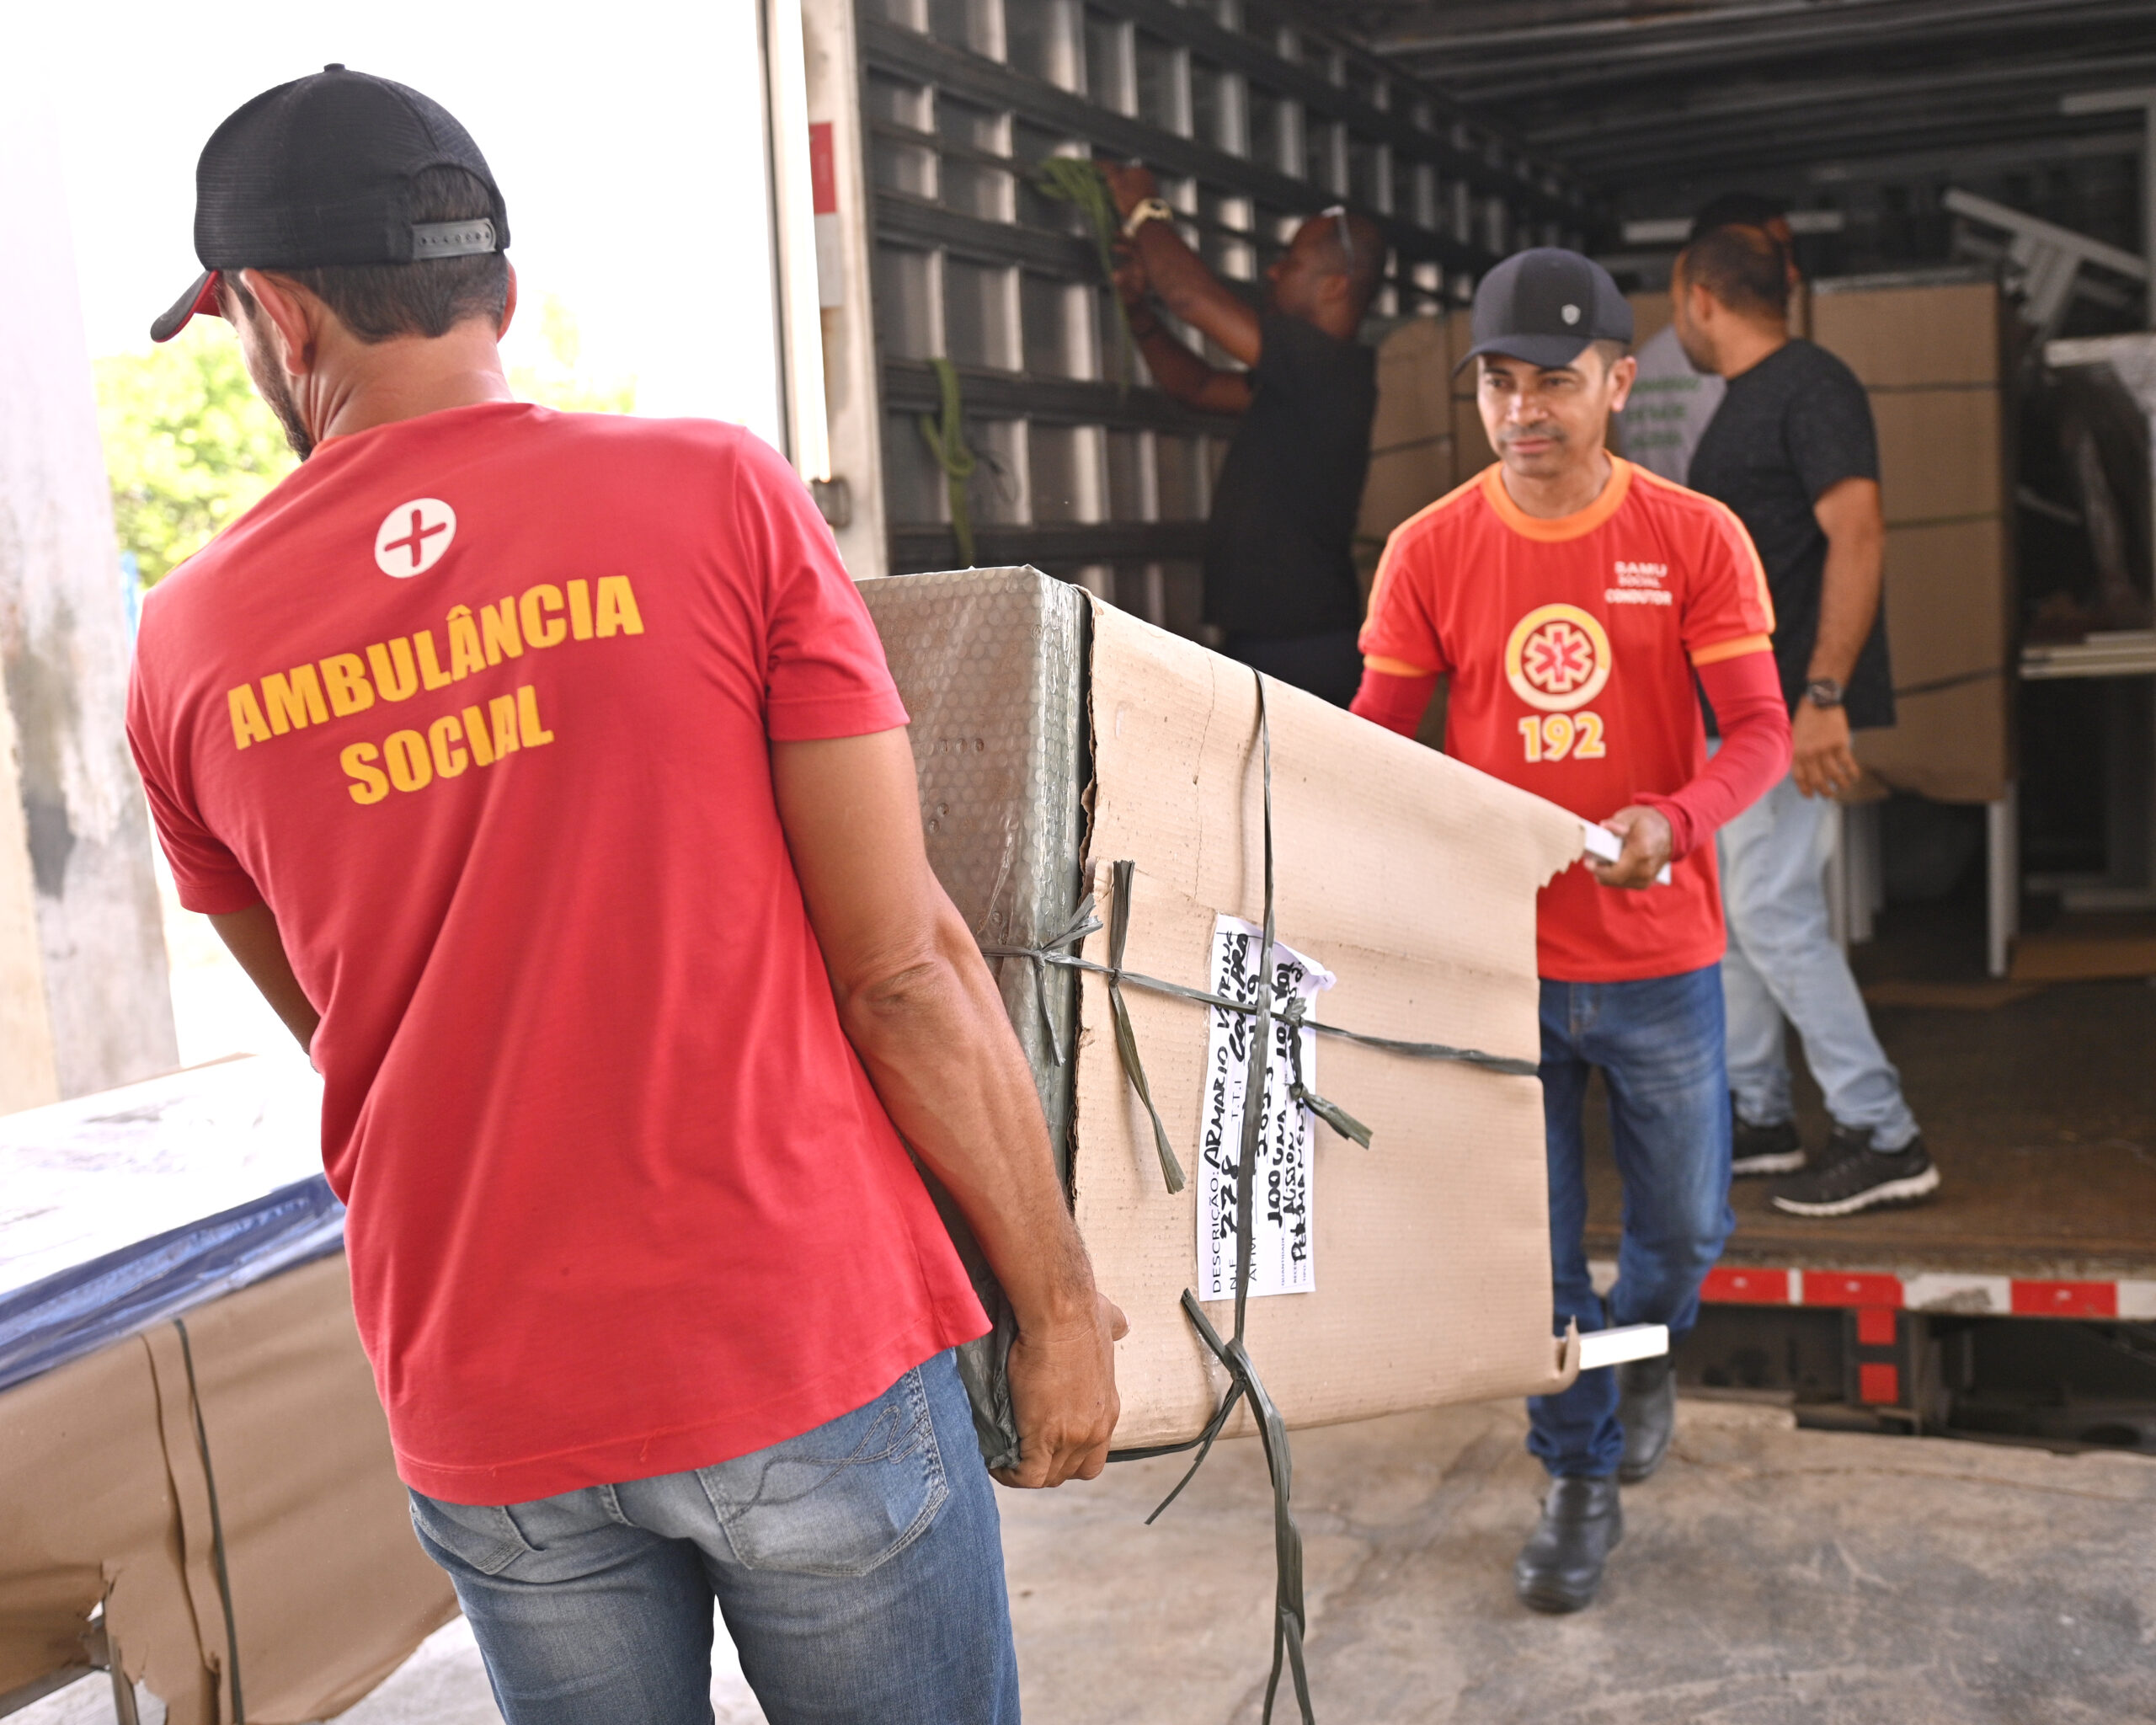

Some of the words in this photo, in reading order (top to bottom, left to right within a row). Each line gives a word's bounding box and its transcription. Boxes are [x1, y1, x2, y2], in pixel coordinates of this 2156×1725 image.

[1614, 561, 1668, 578] SAMU
[227, 574, 645, 750] AMBULÂNCIA
[339, 684, 555, 805] SOCIAL
[1518, 711, 1606, 763] 192
[1209, 1171, 1221, 1294] DESCRIÇÃO:
